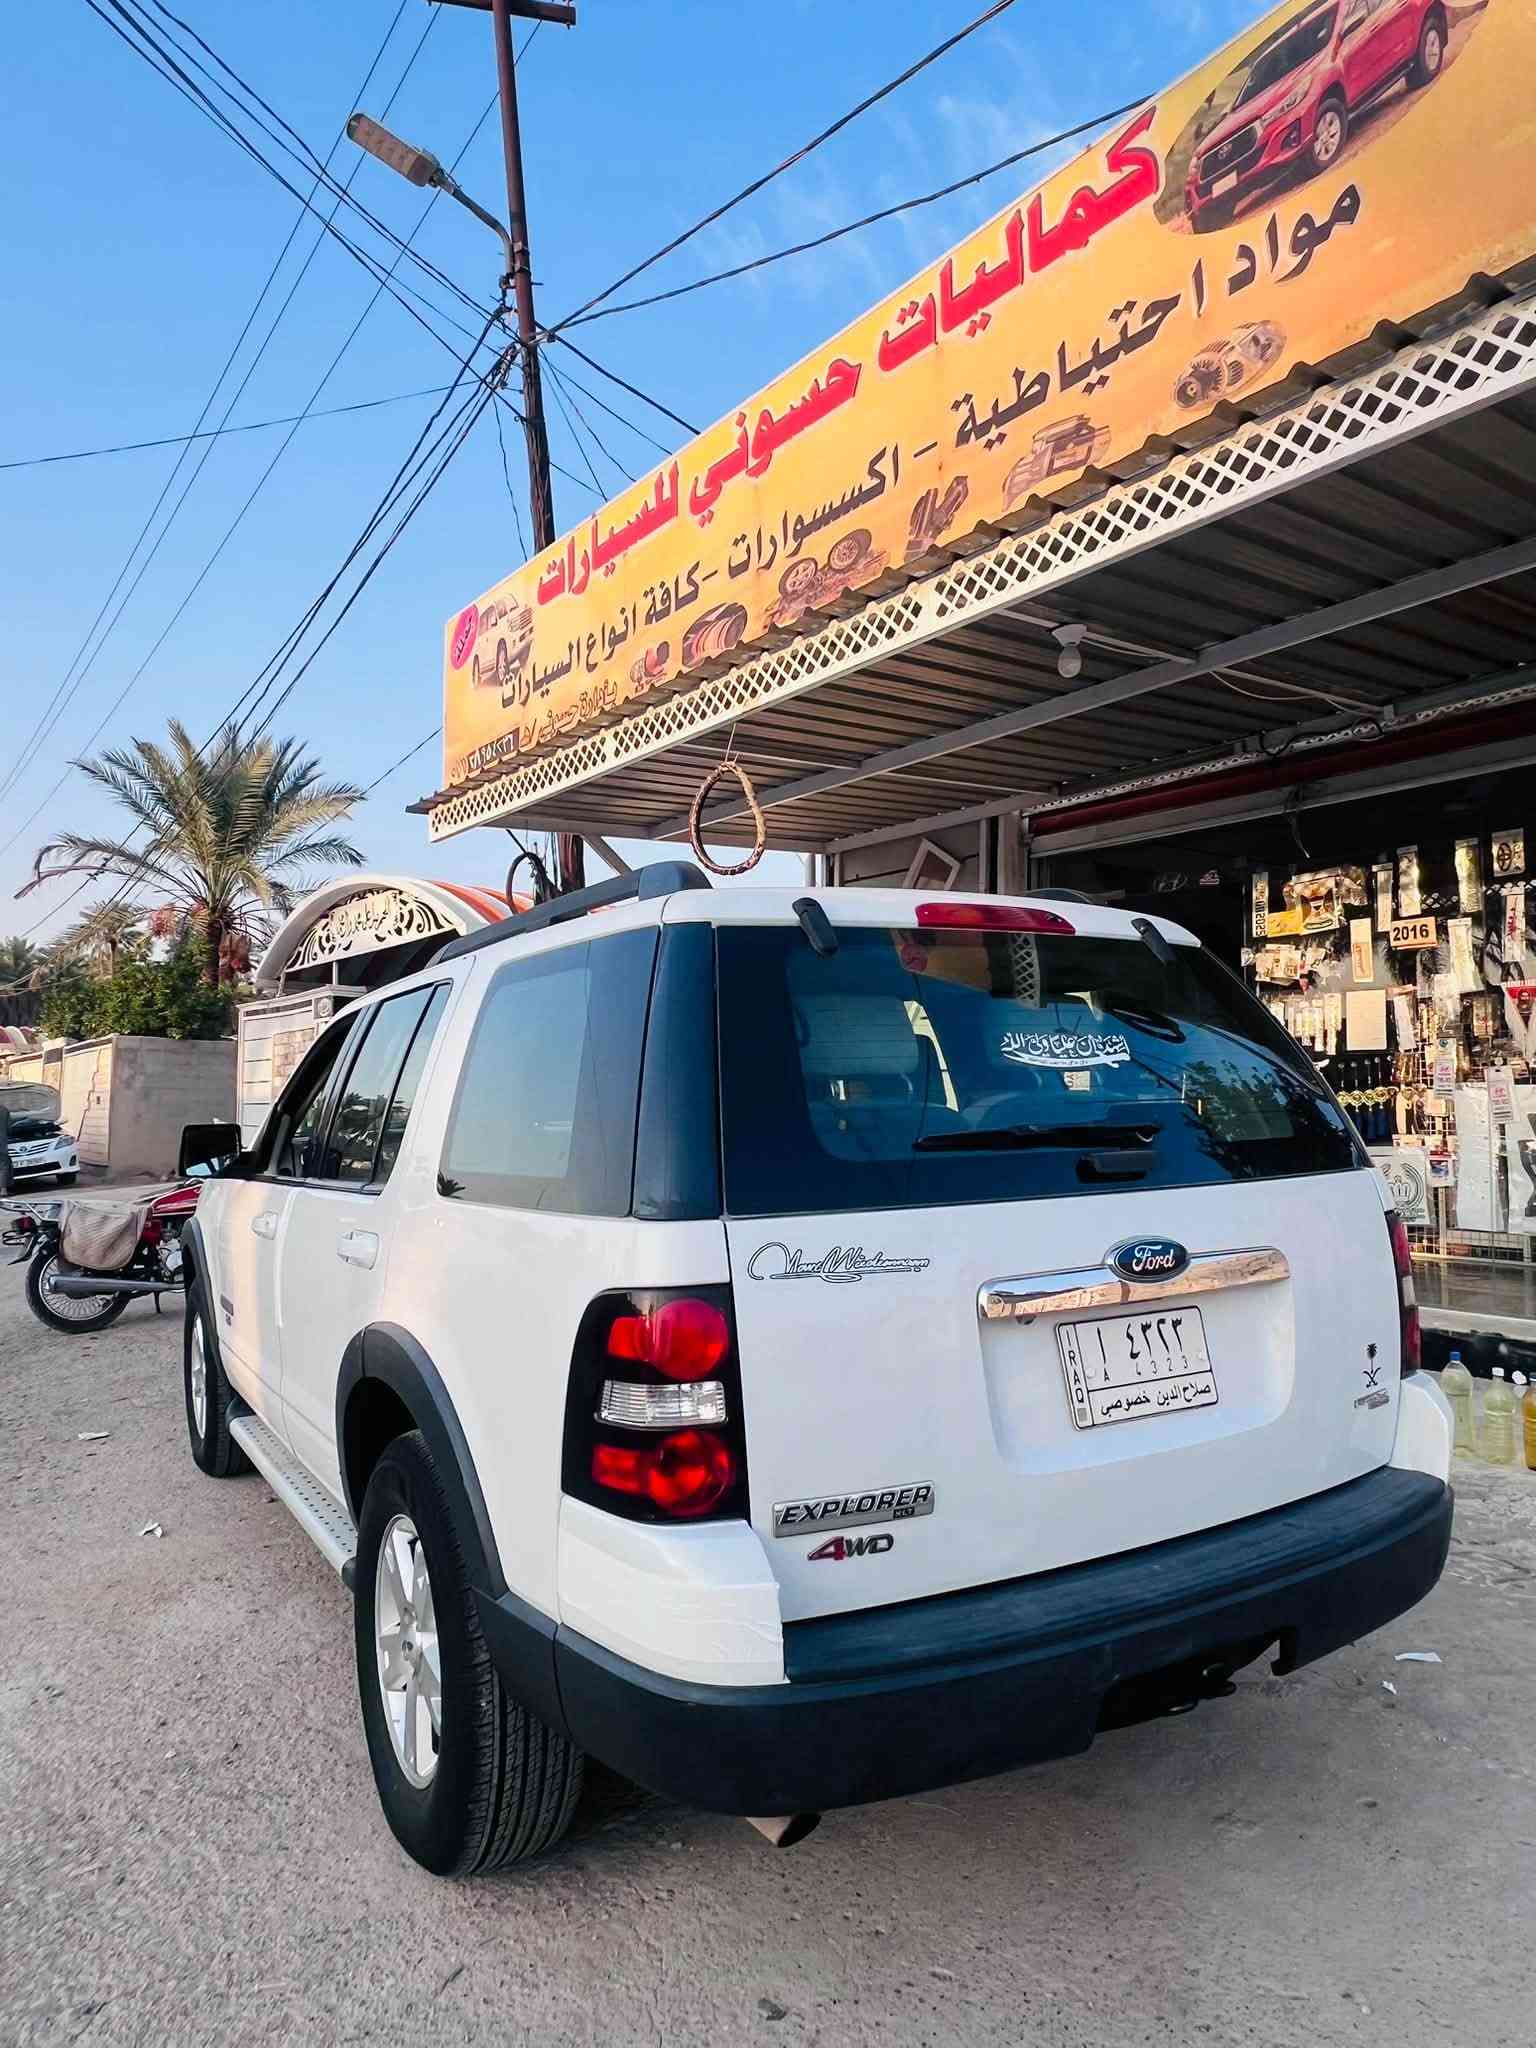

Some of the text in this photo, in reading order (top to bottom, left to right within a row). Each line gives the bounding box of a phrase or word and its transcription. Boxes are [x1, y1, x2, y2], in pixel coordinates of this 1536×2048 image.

[537, 105, 1163, 606] كماليات حسوني للسيارات
[502, 184, 1361, 709] مواد احتياطية اكسسوارات كافة انواع السيارات
[1393, 925, 1430, 941] 2016
[1132, 1244, 1176, 1272] Ford
[1065, 1329, 1085, 1404] IRAQ
[1100, 1389, 1151, 1417] خصوصي
[777, 1485, 932, 1525] EXPLORER
[807, 1533, 895, 1561] 4WD
